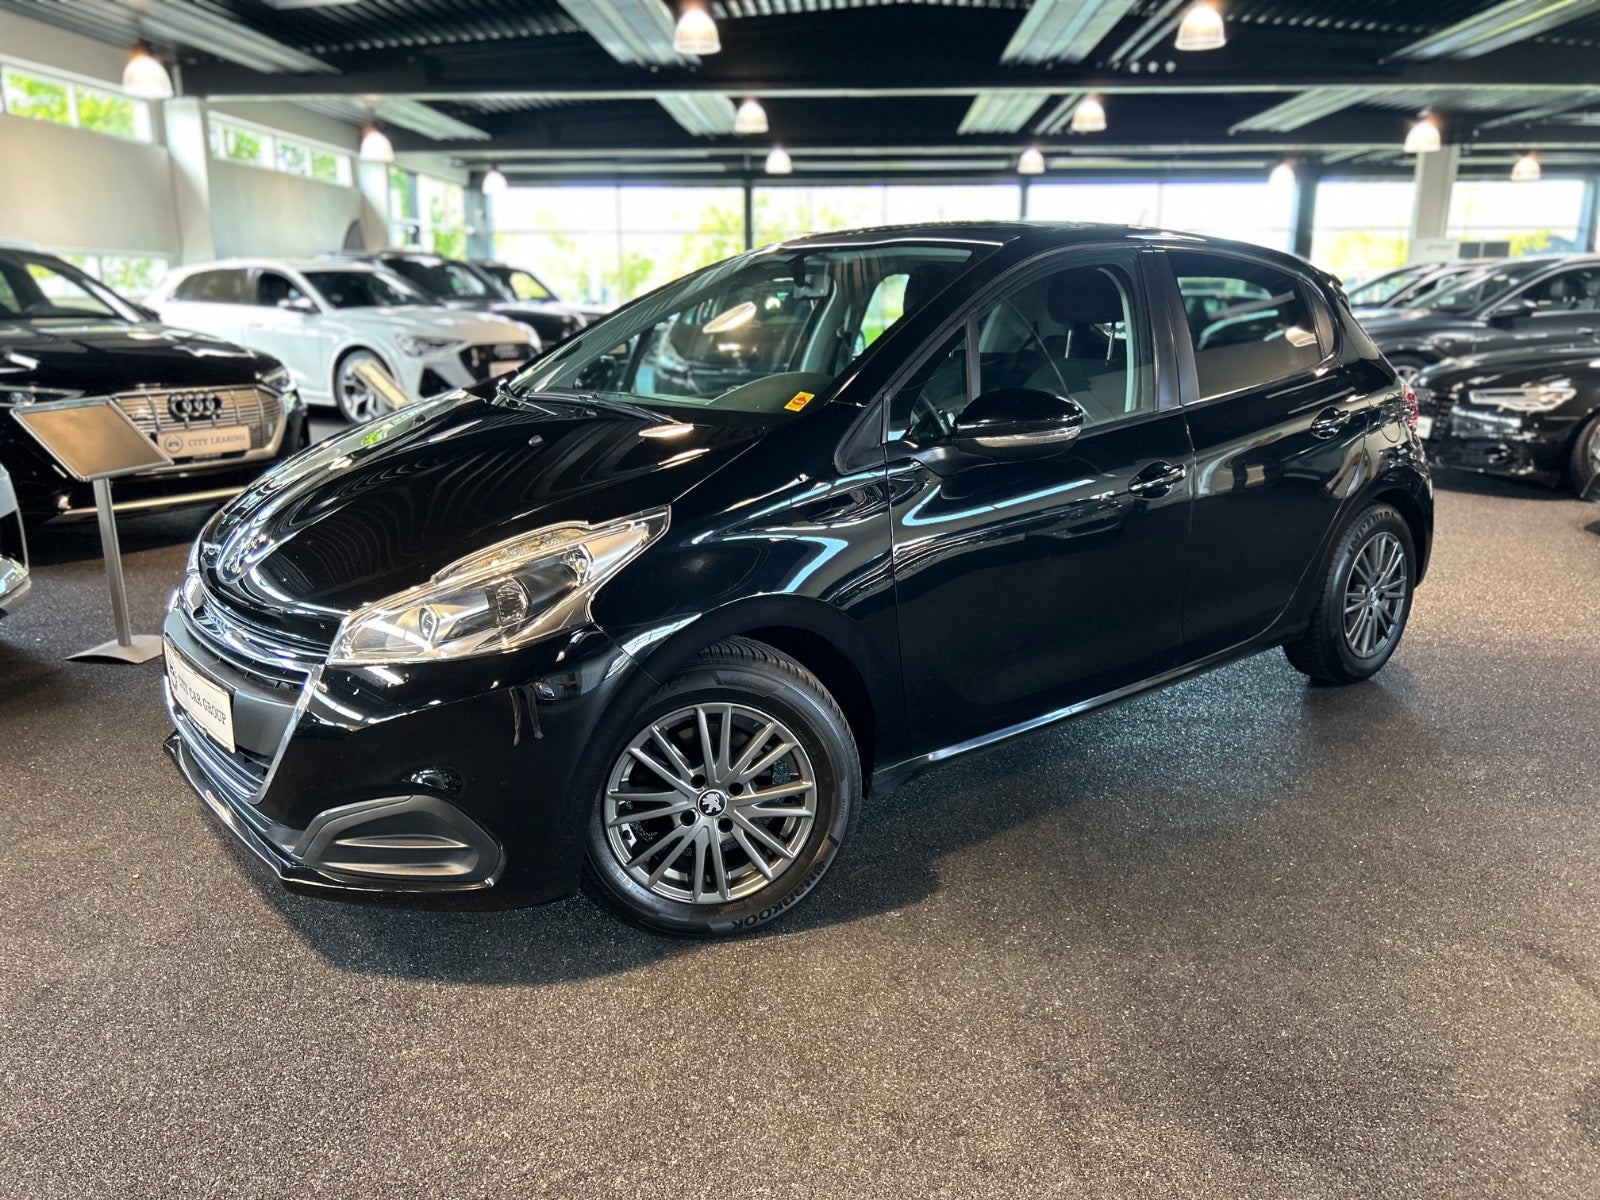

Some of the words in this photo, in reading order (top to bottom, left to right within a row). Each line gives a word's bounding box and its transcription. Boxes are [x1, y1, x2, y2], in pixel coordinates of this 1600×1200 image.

[188, 438, 208, 447] CITY
[211, 434, 246, 445] LEASING
[188, 688, 203, 708] CAR
[202, 697, 227, 726] GROUP
